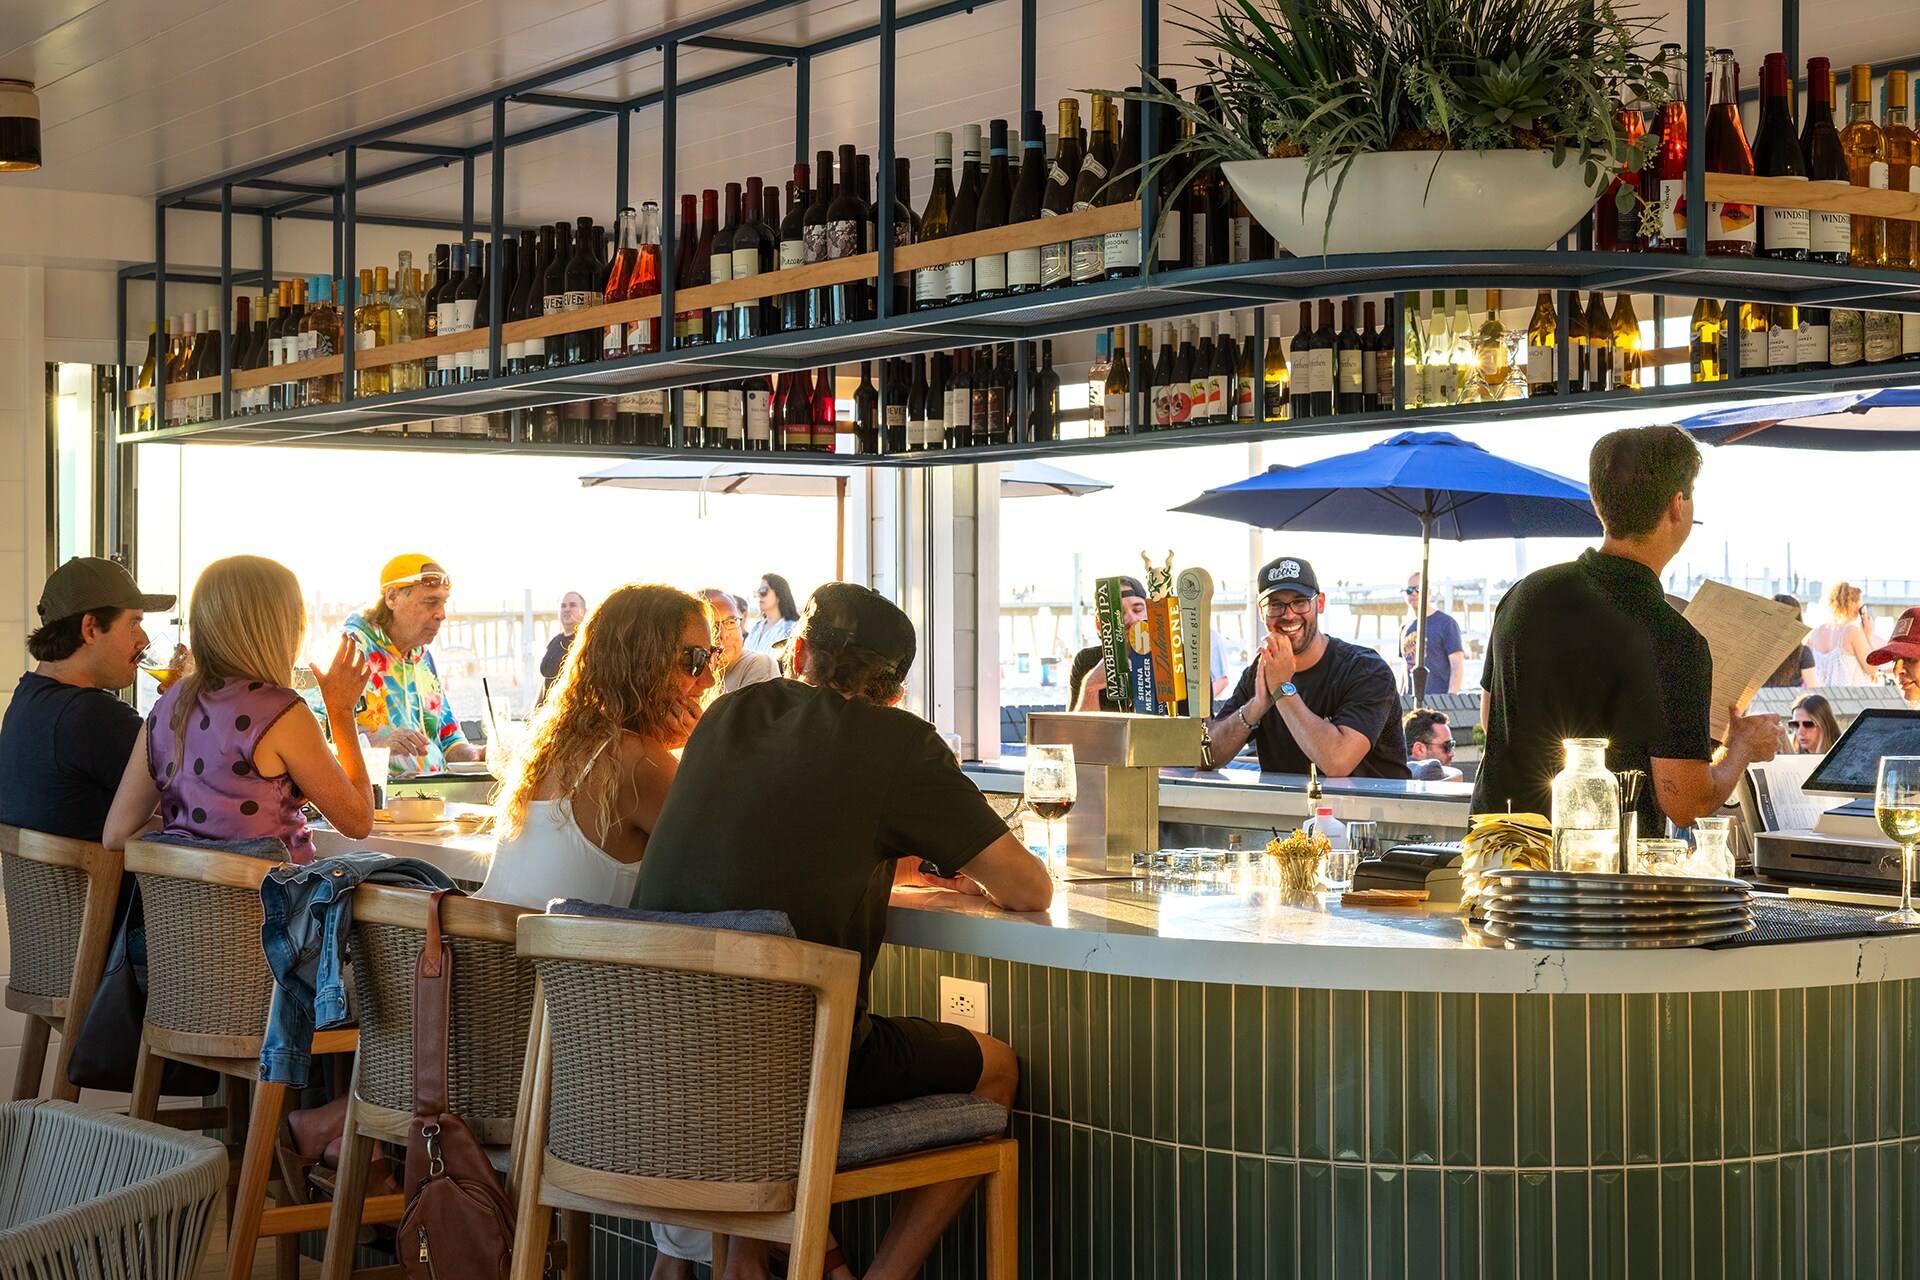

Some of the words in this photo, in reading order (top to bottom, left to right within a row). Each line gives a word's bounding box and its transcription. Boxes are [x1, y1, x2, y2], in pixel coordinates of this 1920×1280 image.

[1098, 583, 1110, 613] IPA
[1182, 607, 1198, 628] girl
[1152, 610, 1174, 680] Delicious
[1171, 604, 1184, 674] STONE
[1189, 633, 1198, 670] surfer
[1101, 618, 1119, 697] MAYBERRY
[1137, 667, 1145, 701] SIRENA
[1157, 686, 1173, 696] IPA
